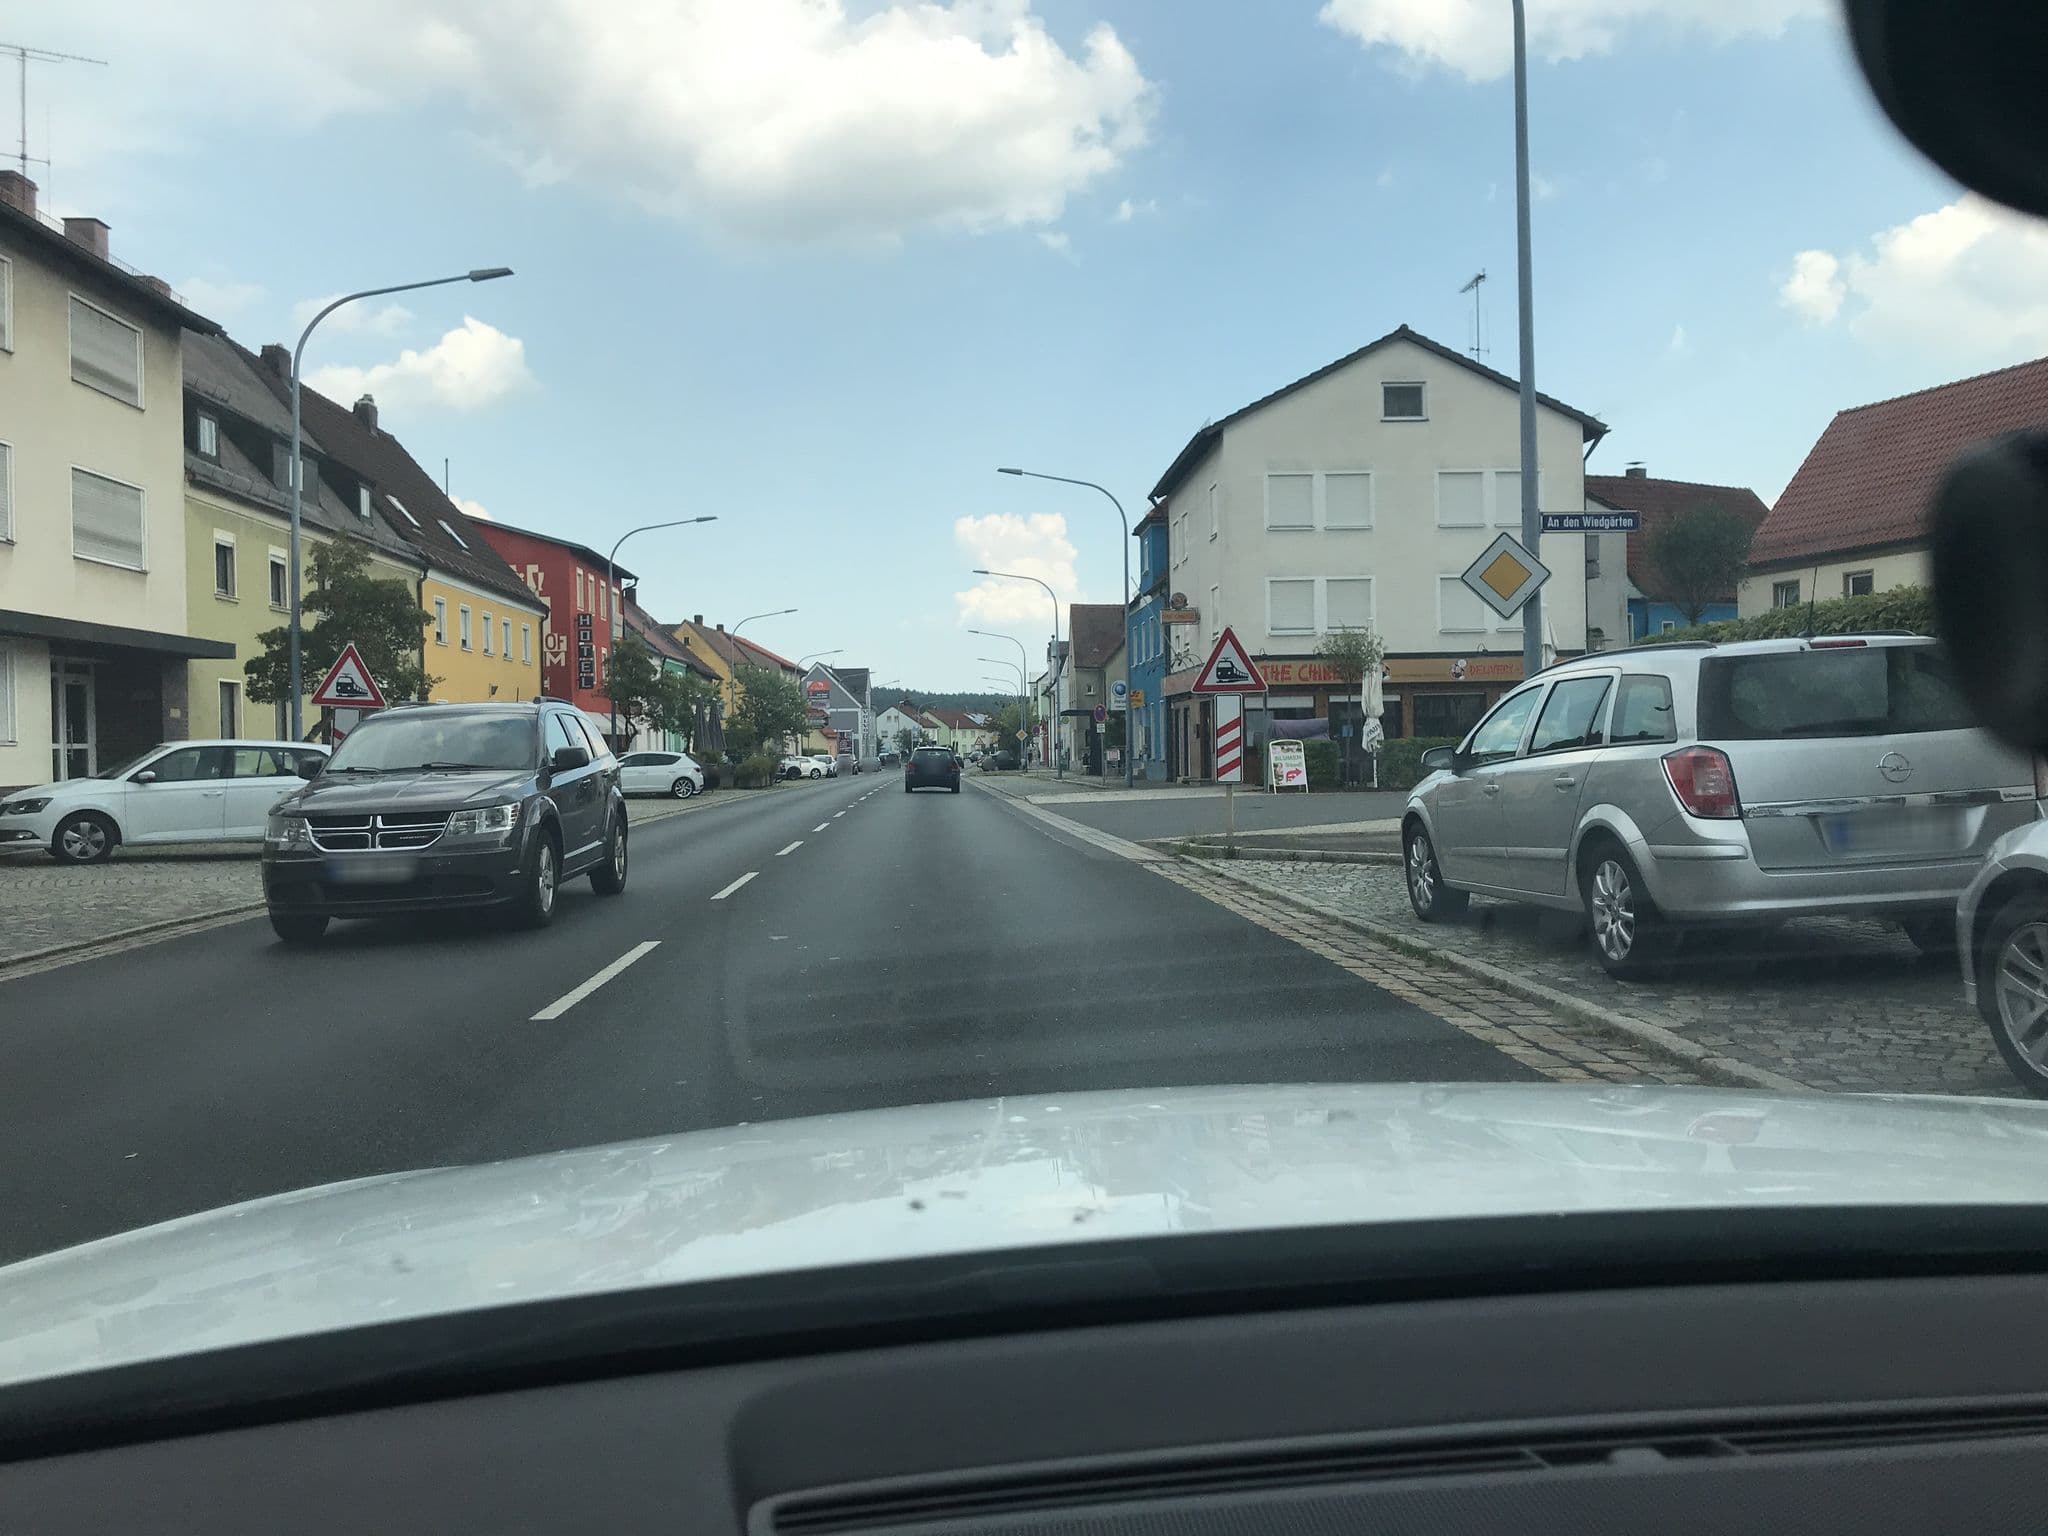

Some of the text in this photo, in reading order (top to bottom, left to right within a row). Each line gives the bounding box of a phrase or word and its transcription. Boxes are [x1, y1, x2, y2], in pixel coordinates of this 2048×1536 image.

[1547, 516, 1560, 528] An
[1563, 516, 1580, 528] den
[579, 615, 592, 688] HOTEL
[1261, 664, 1292, 681] THE
